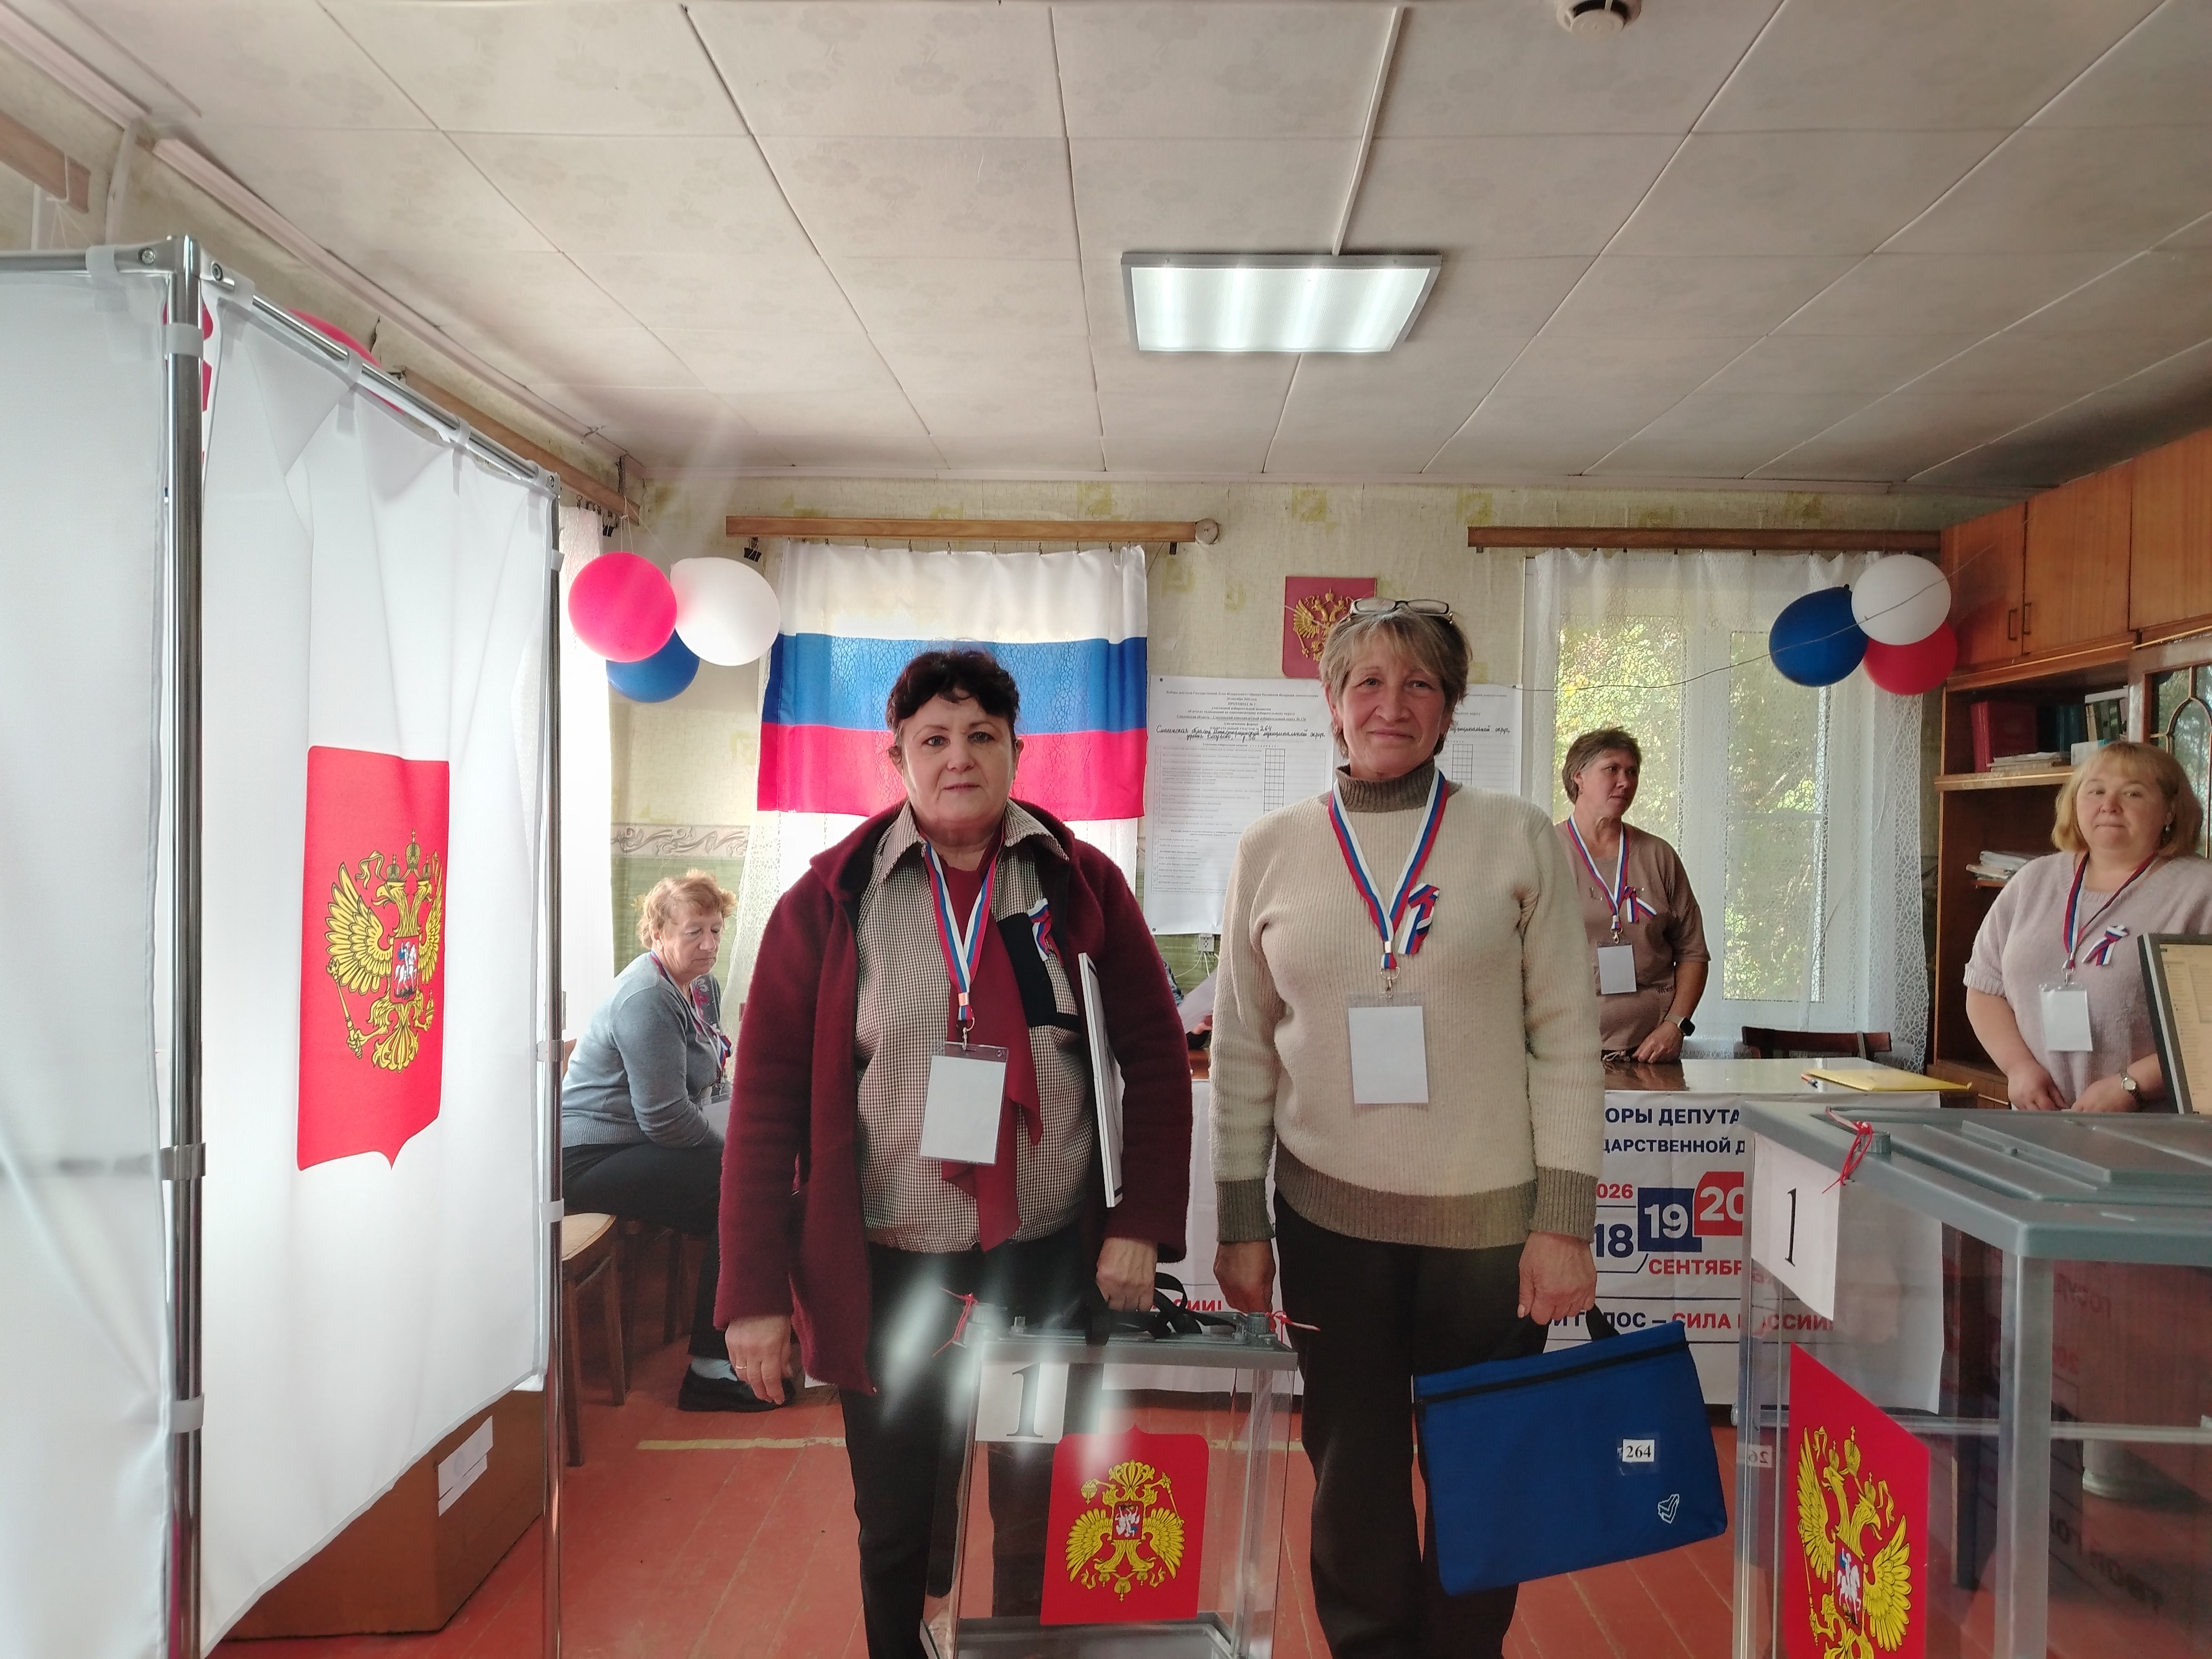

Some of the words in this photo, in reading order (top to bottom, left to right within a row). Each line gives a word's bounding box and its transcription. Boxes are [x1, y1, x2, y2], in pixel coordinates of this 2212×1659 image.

[1644, 1203, 1688, 1239] 19
[1784, 1188, 1797, 1267] 1
[1594, 1223, 1634, 1258] 18
[1006, 1363, 1044, 1438] 1
[1626, 1444, 1651, 1458] 264
